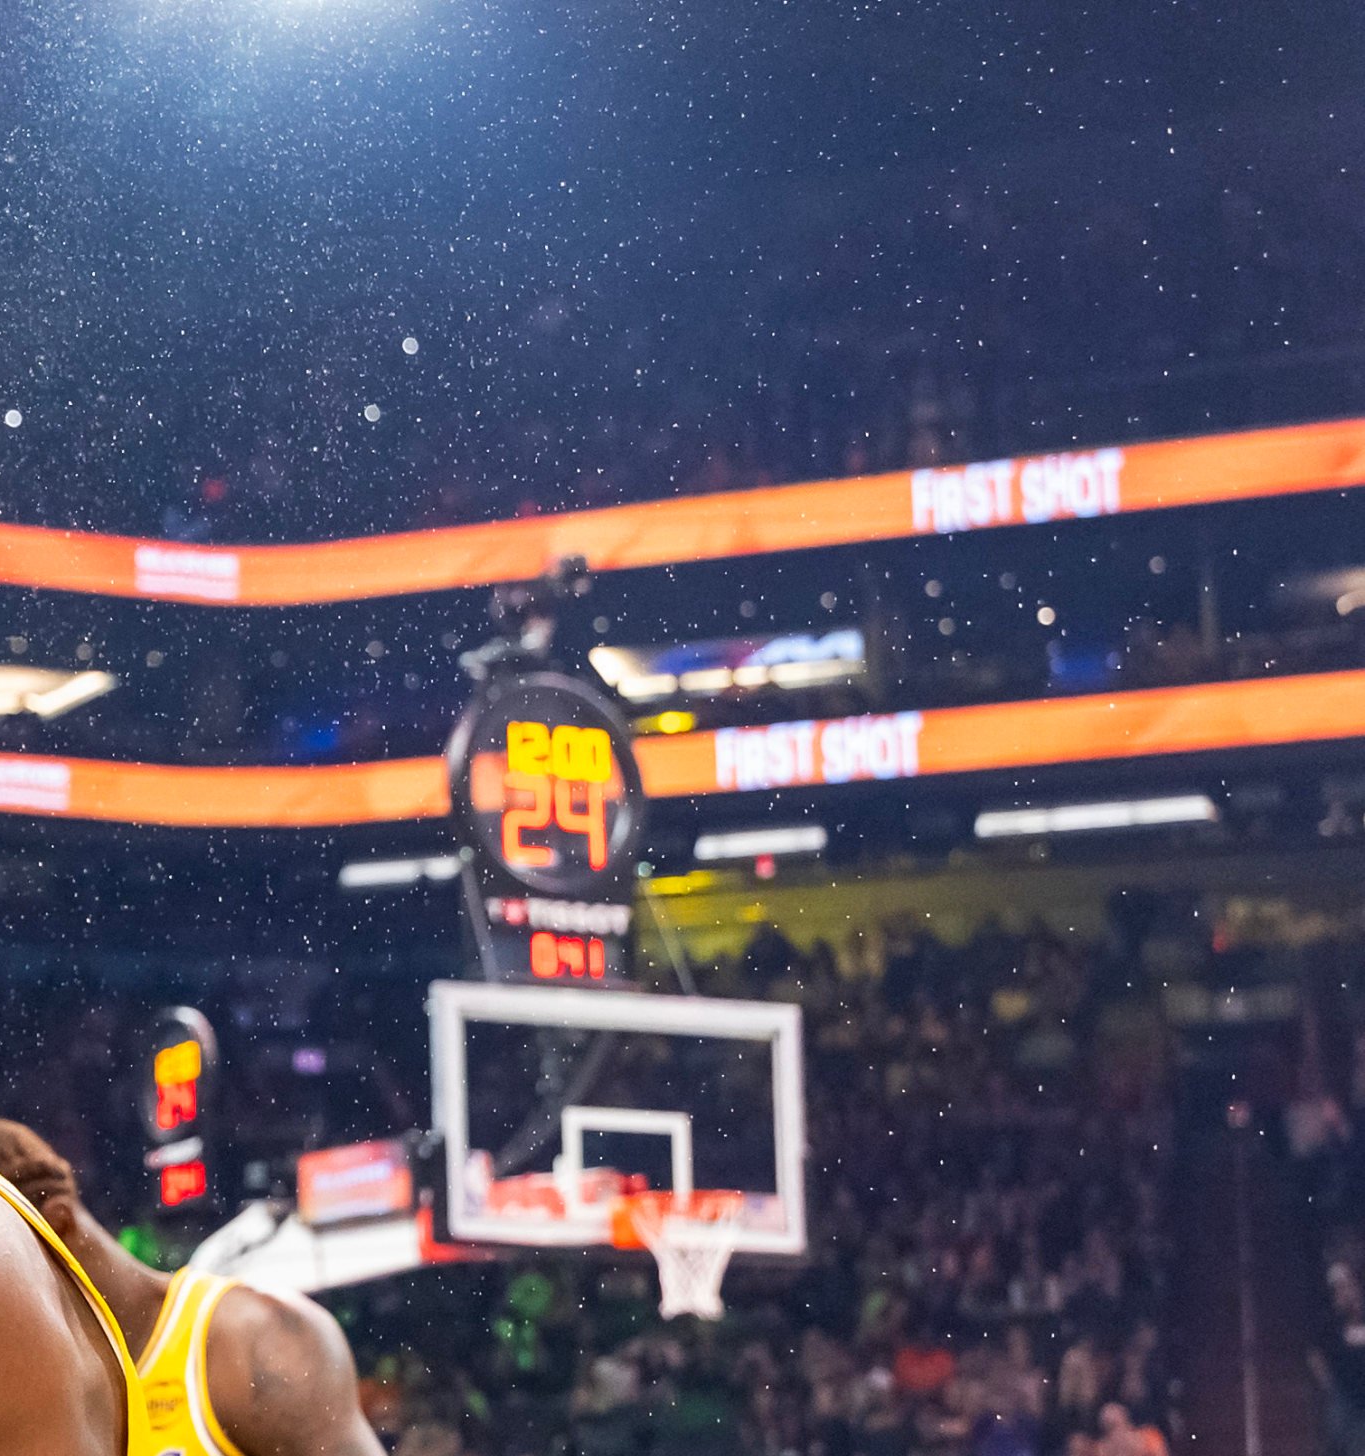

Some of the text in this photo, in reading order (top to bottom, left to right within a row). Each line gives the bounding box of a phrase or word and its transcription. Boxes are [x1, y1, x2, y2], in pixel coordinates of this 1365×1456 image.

[910, 447, 1126, 534] FIRST SHOT
[715, 710, 924, 791] FIRST SHOT
[501, 770, 608, 871] 24
